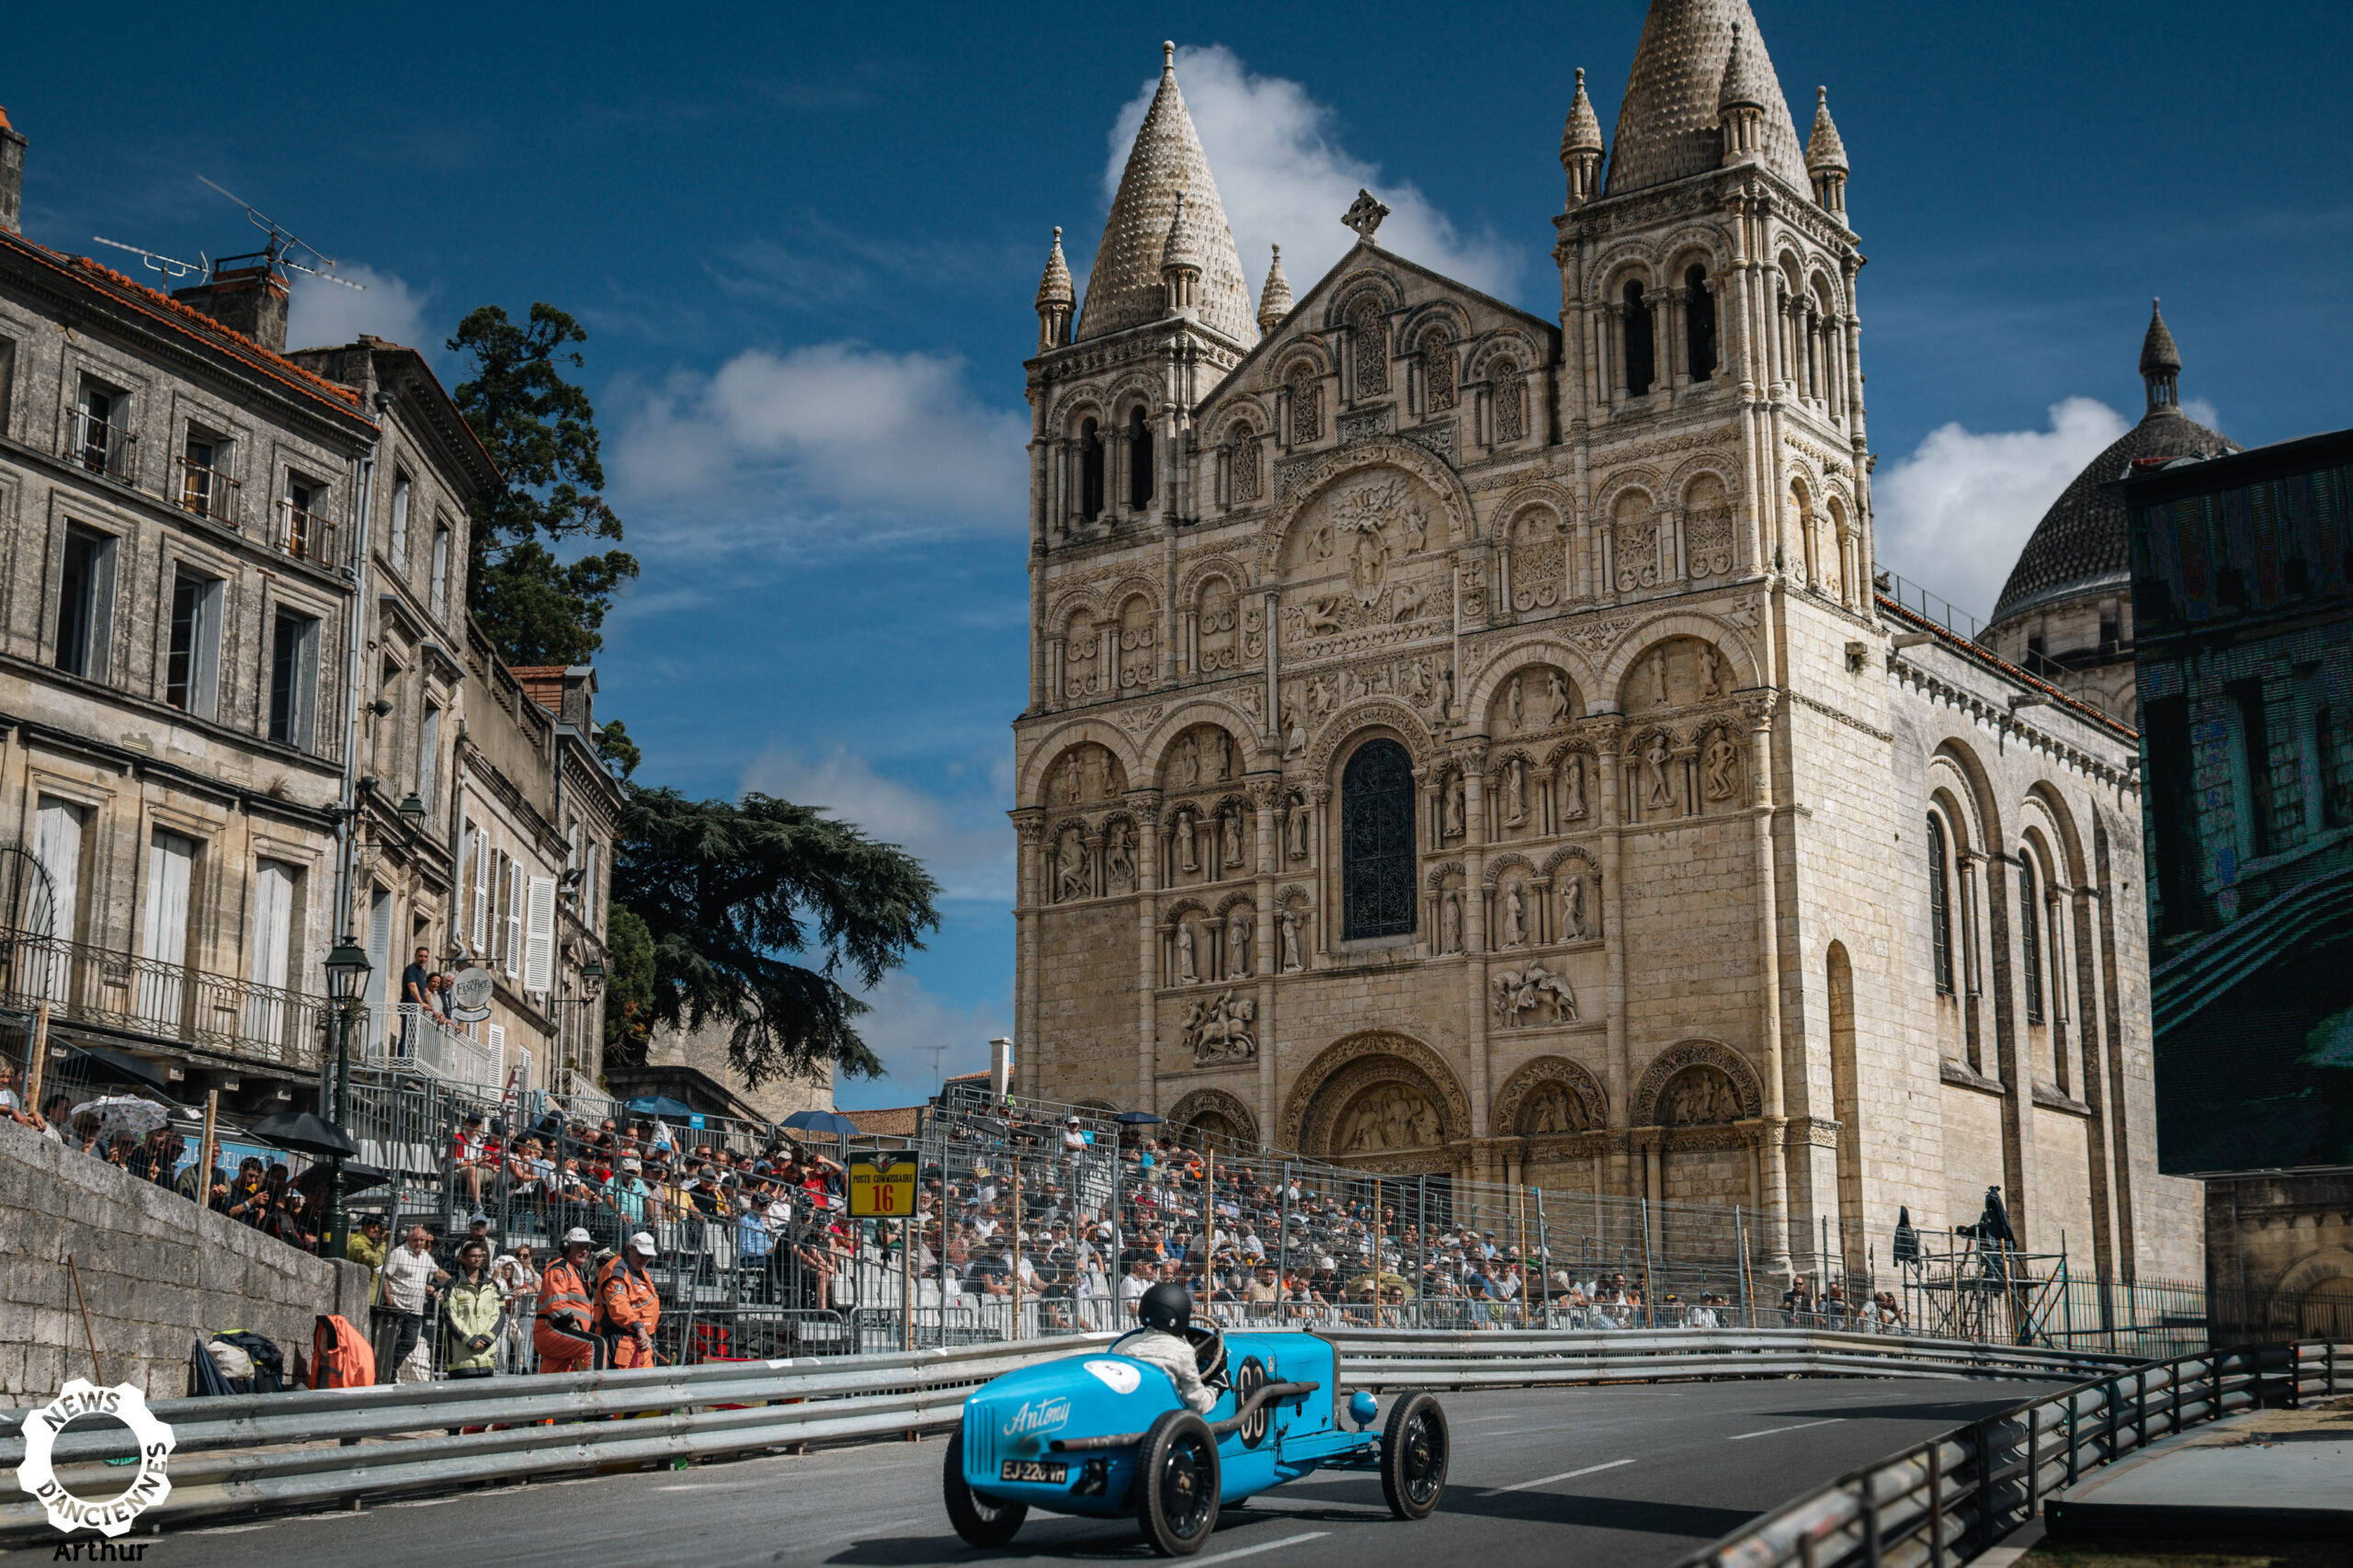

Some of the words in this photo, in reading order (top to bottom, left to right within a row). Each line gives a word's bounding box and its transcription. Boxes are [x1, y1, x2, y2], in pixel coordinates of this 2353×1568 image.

[220, 1151, 241, 1170] JEU
[853, 1174, 870, 1184] POSTE
[873, 1174, 913, 1183] COMMISSAIRE
[872, 1184, 893, 1211] 16
[1003, 1396, 1071, 1444] Antony
